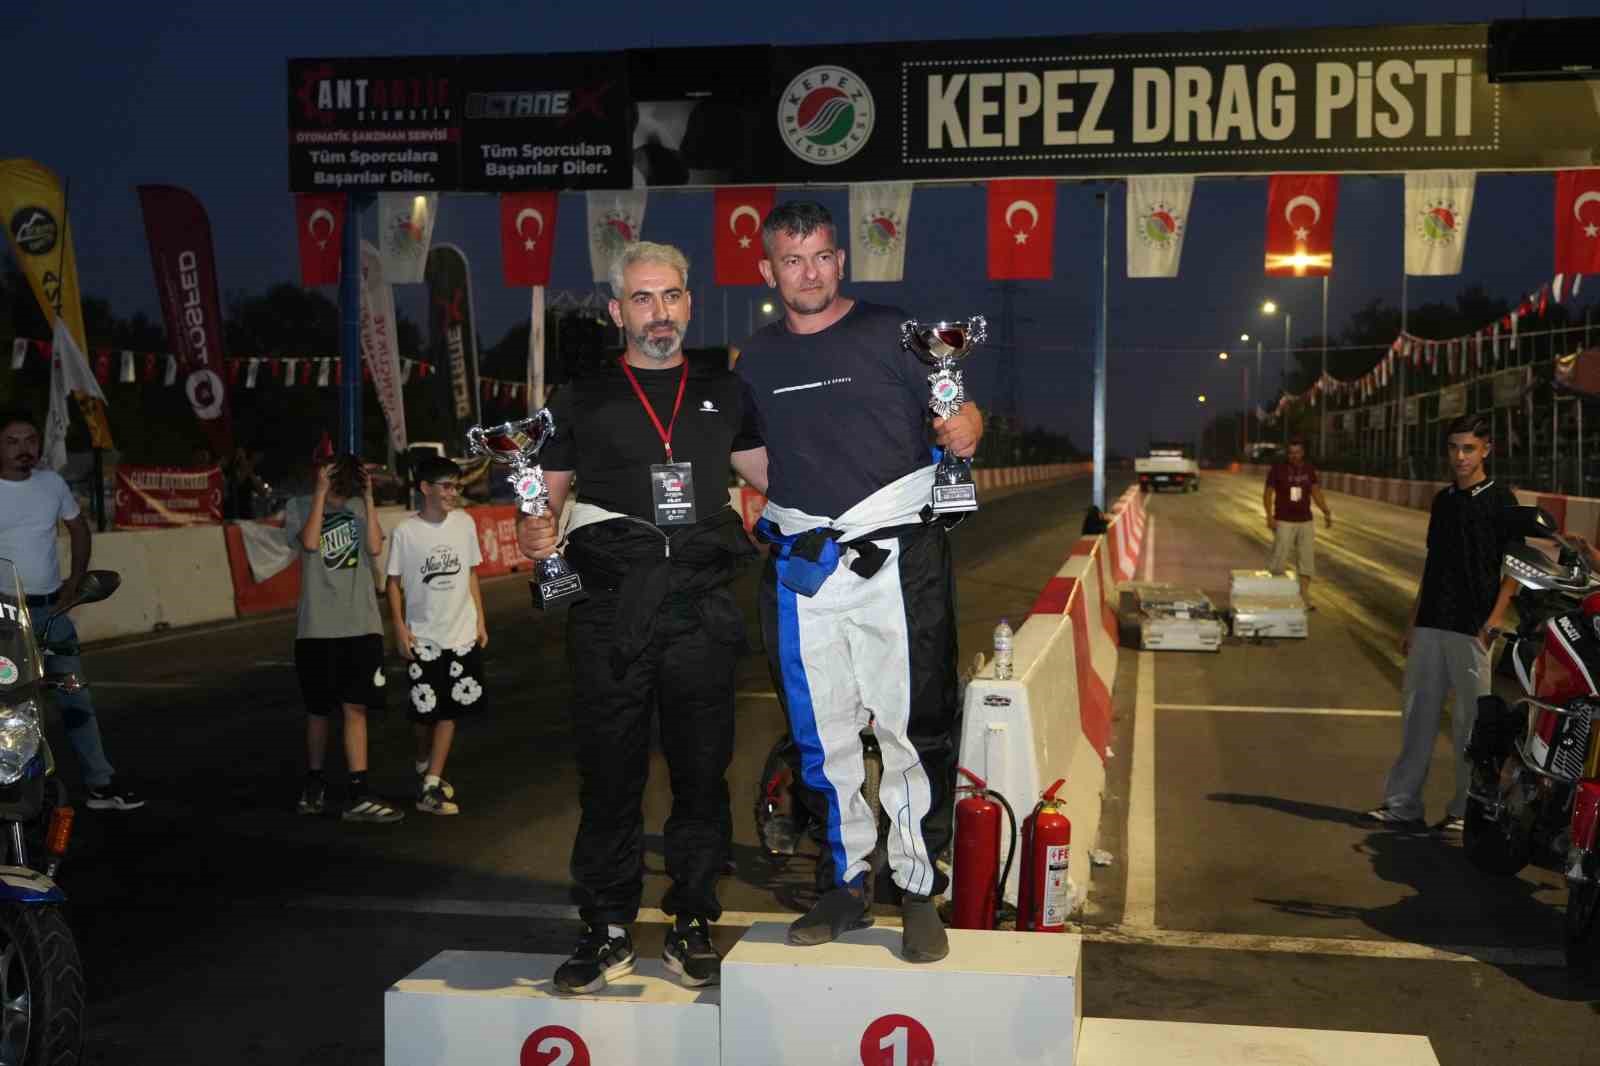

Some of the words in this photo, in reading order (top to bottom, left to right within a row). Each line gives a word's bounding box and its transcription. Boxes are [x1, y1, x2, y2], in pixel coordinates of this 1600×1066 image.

[788, 73, 863, 106] KEPEZ
[928, 71, 1115, 149] KEPEZ
[1133, 62, 1296, 143] DRAG
[310, 149, 345, 163] Tüm
[350, 147, 440, 166] Sporculara
[480, 144, 518, 158] Tüm
[522, 142, 612, 161] Sporculara
[313, 170, 386, 187] Başarılar
[390, 168, 436, 183] Diler.
[485, 162, 560, 179] Başarılar
[562, 160, 608, 175] Diler.
[420, 556, 442, 573] New
[536, 1037, 575, 1066] 2
[879, 1026, 909, 1066] 1
